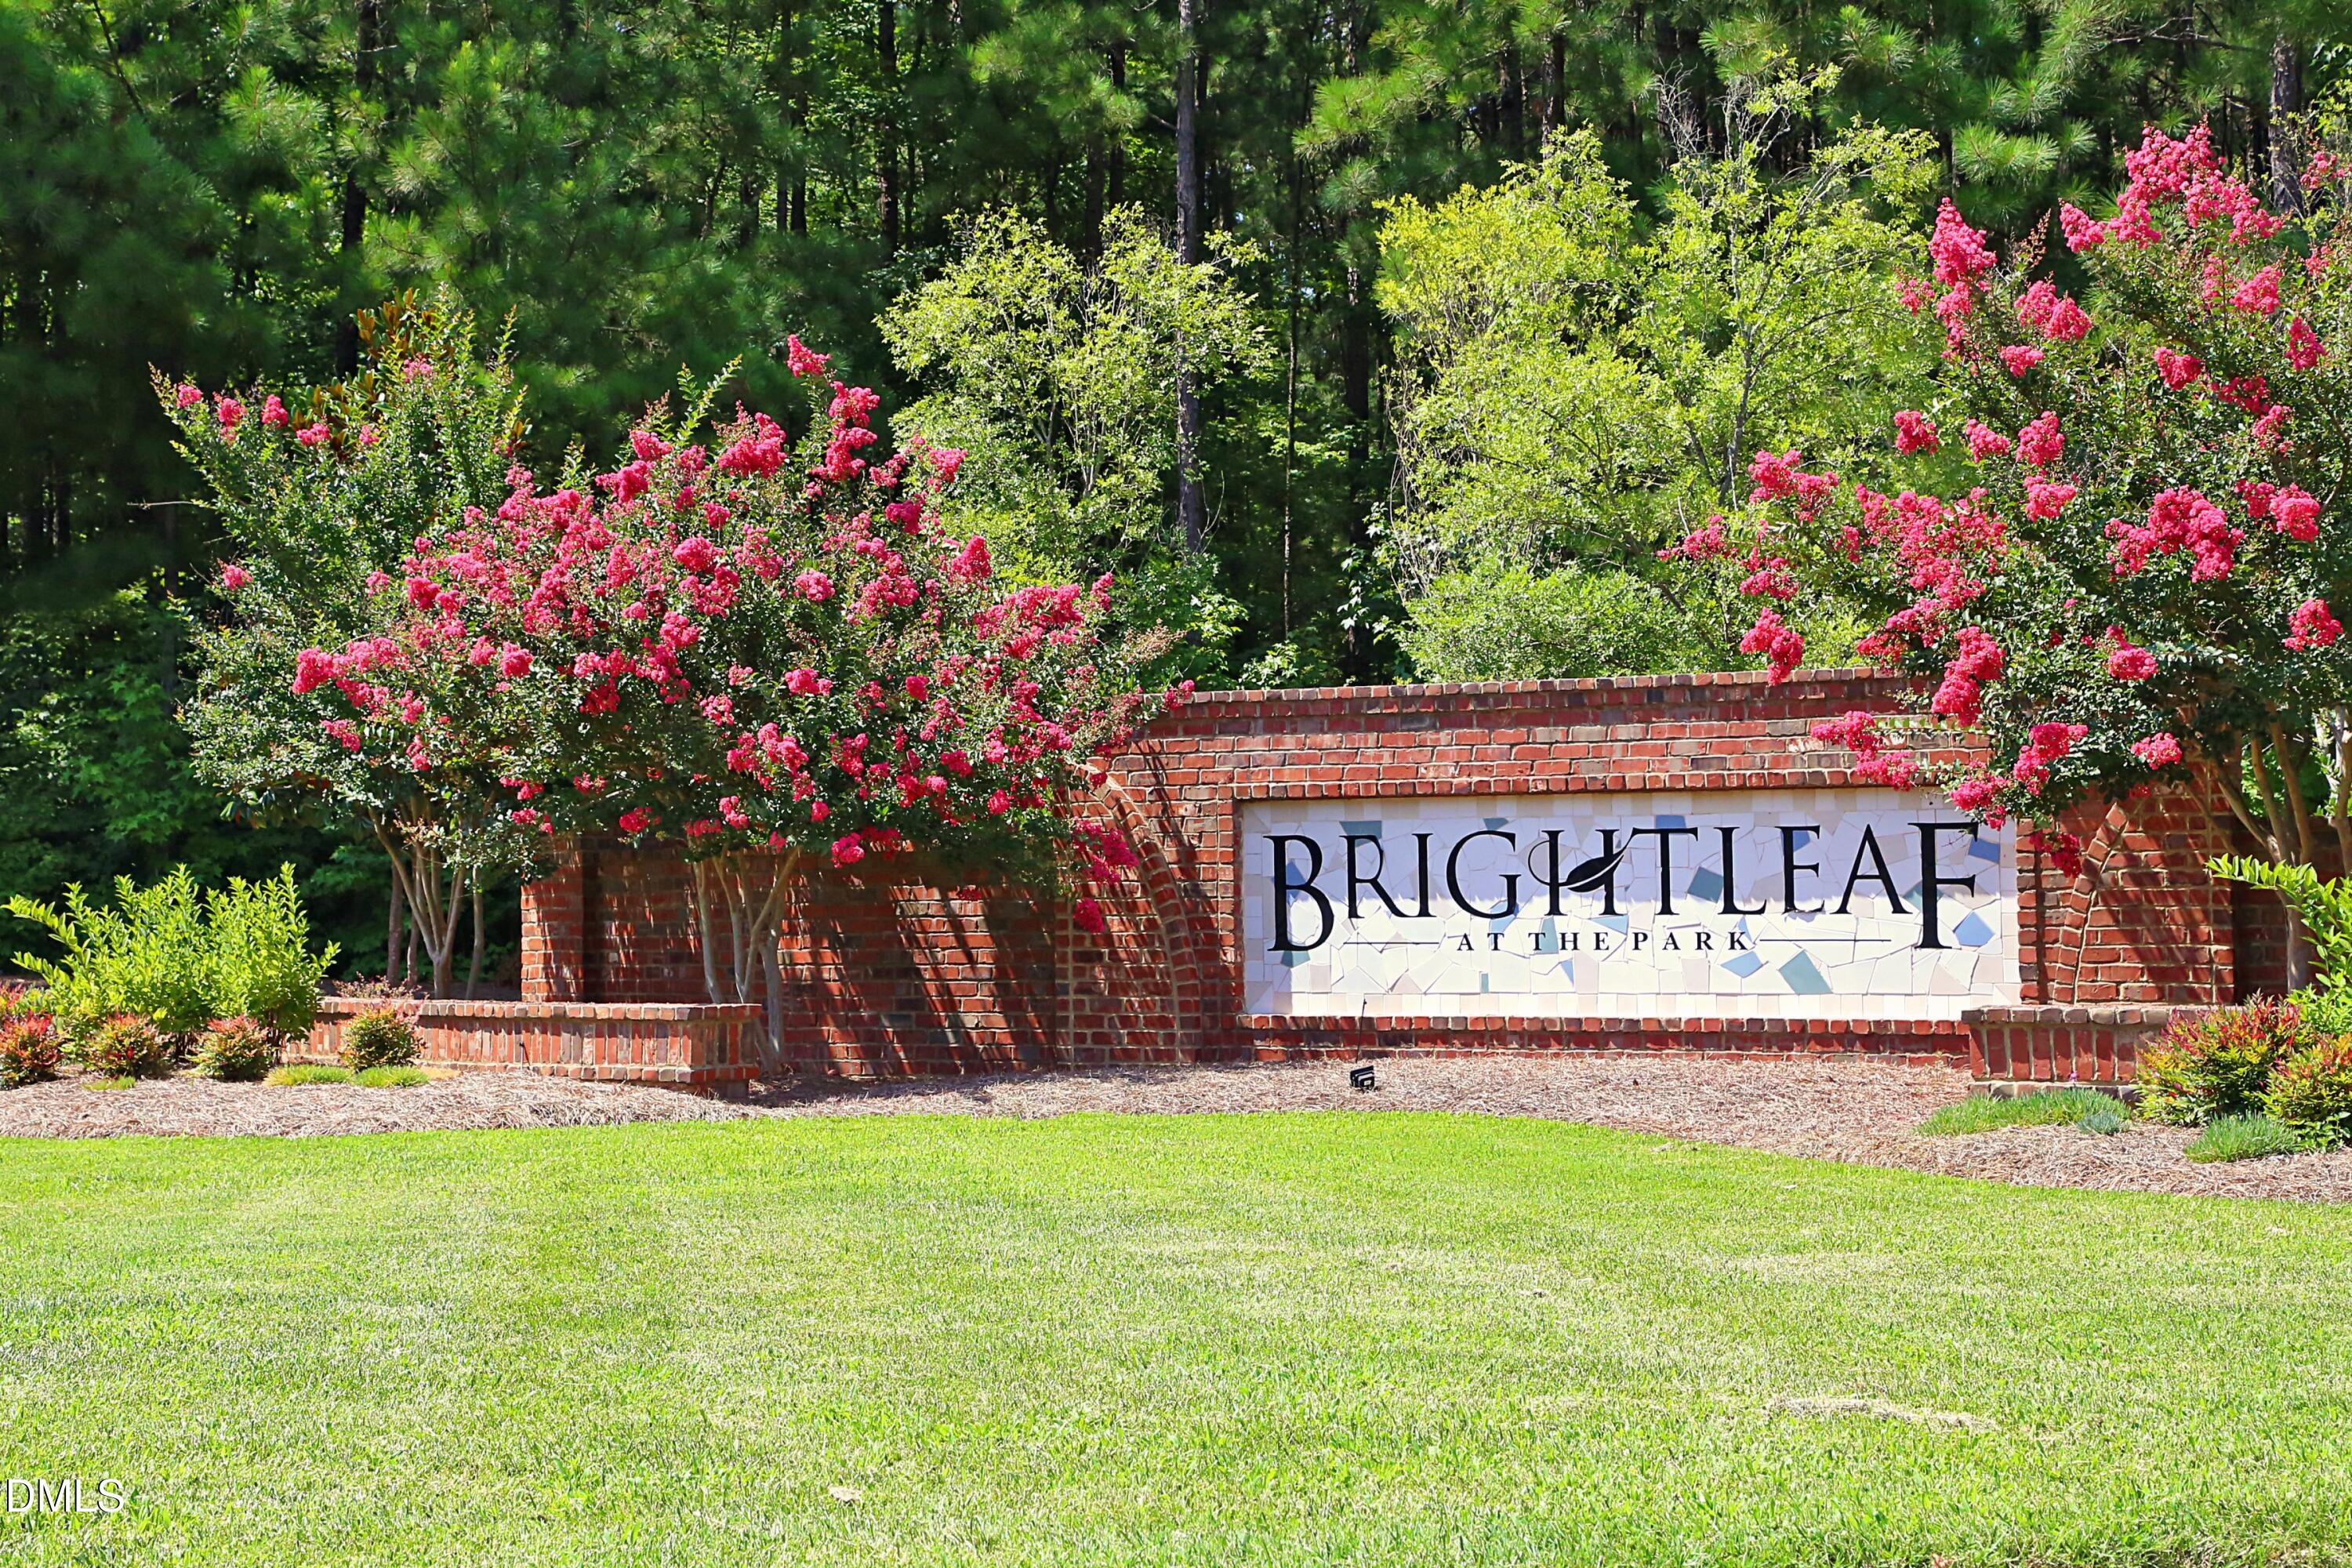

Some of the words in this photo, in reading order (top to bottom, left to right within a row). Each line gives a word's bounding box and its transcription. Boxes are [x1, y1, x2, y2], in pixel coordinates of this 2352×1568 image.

[1263, 822, 1980, 952] BRIGHTLEAF
[1457, 931, 1505, 951] AT
[1527, 931, 1611, 951] THE
[1632, 931, 1750, 951] PARK
